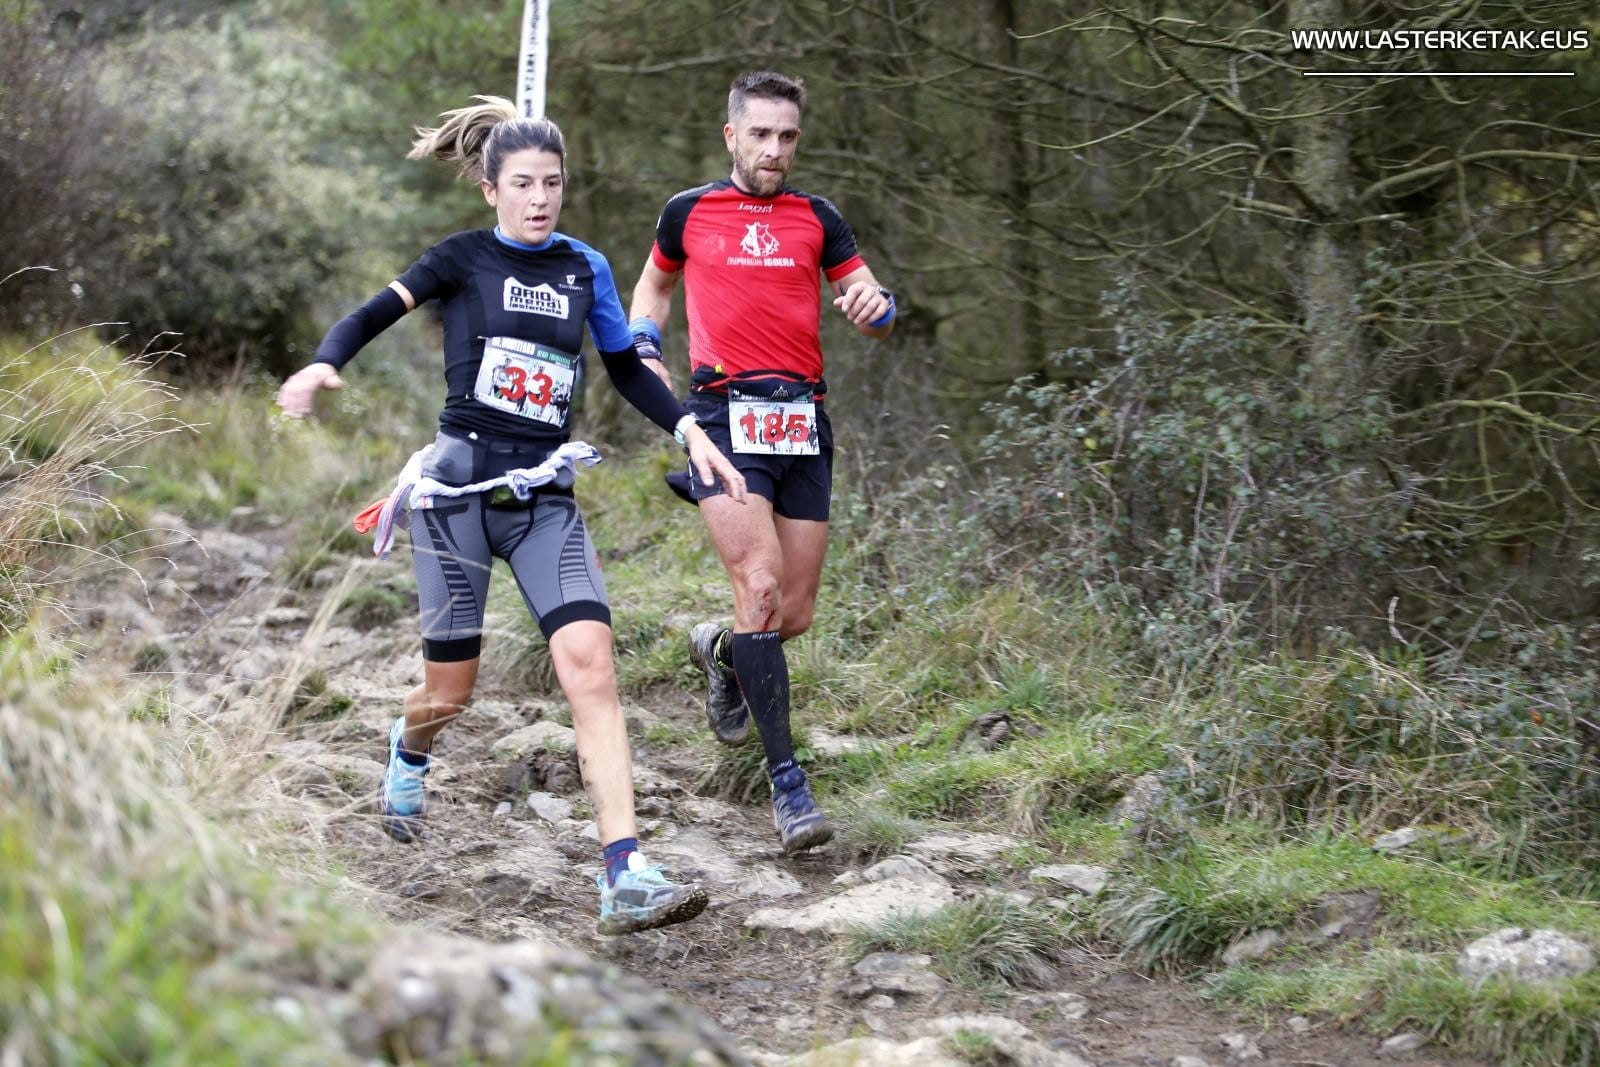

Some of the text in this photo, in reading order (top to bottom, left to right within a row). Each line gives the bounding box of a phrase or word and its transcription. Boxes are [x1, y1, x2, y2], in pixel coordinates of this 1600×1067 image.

[511, 286, 551, 301] ORIO
[510, 296, 561, 309] mendi
[510, 302, 562, 315] lasterketa
[500, 367, 553, 407] 33
[740, 413, 809, 443] 185
